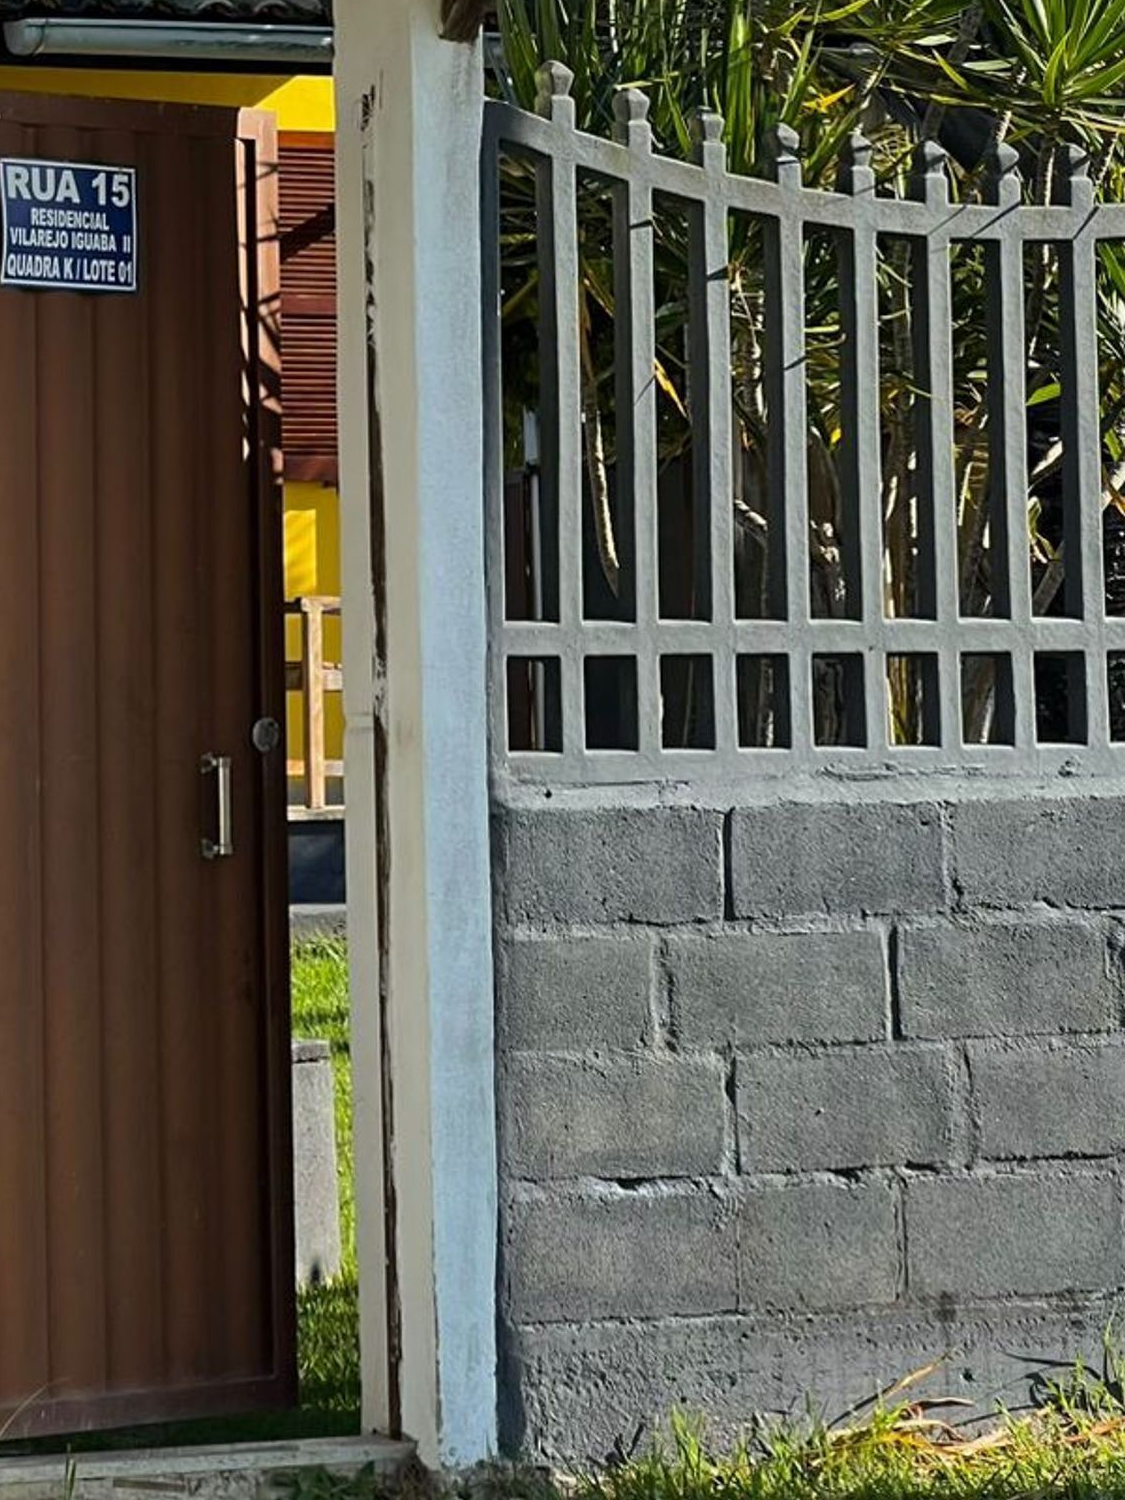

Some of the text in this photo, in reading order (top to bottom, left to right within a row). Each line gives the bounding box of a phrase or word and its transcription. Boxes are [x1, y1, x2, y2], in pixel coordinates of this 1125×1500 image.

[6, 165, 130, 207] RUA 15
[31, 208, 109, 230] RESIDENCIAL
[10, 227, 131, 253] VILAREJO IGUABA II
[7, 254, 60, 278] QUADRA
[64, 258, 73, 279] K
[83, 258, 115, 282] LOTE
[118, 262, 132, 283] 01
